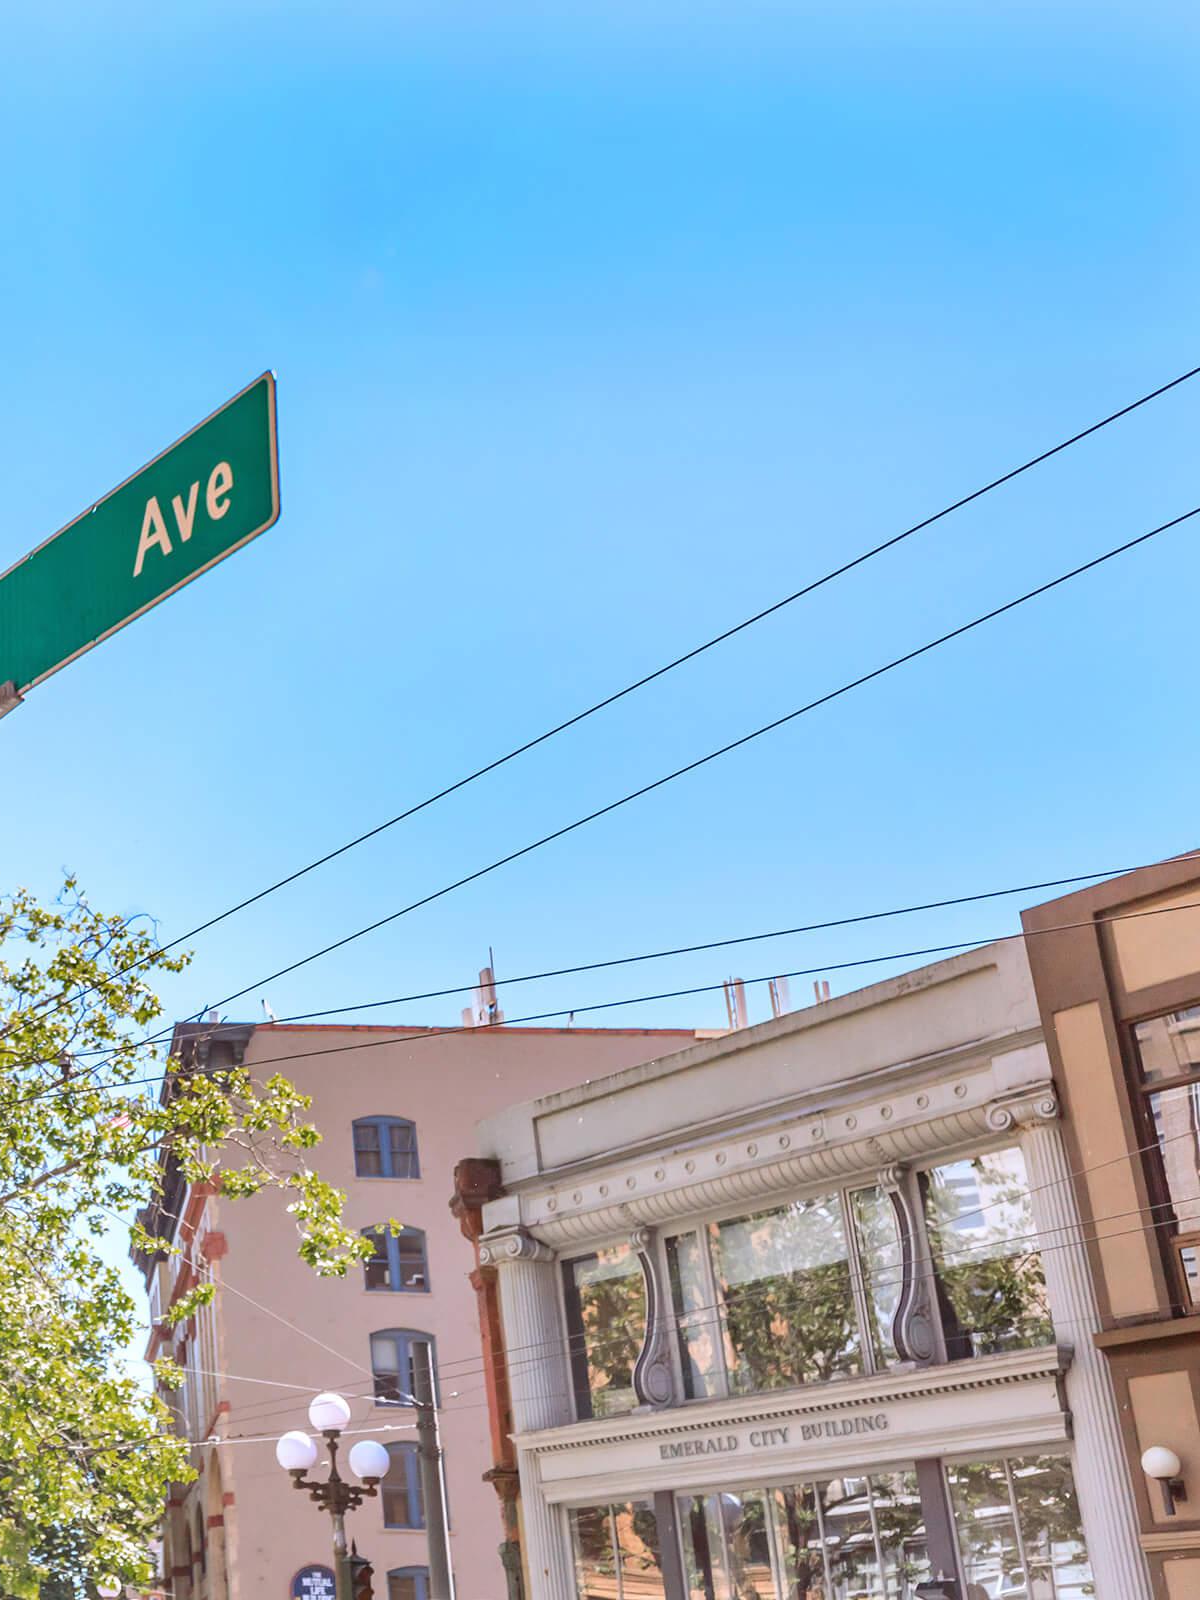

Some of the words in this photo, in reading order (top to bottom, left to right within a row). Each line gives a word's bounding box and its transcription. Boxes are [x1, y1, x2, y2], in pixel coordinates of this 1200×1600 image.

[133, 461, 234, 577] Ave
[659, 1434, 738, 1460] EMERALD
[749, 1426, 790, 1448] CITY
[800, 1413, 888, 1441] BUILDING
